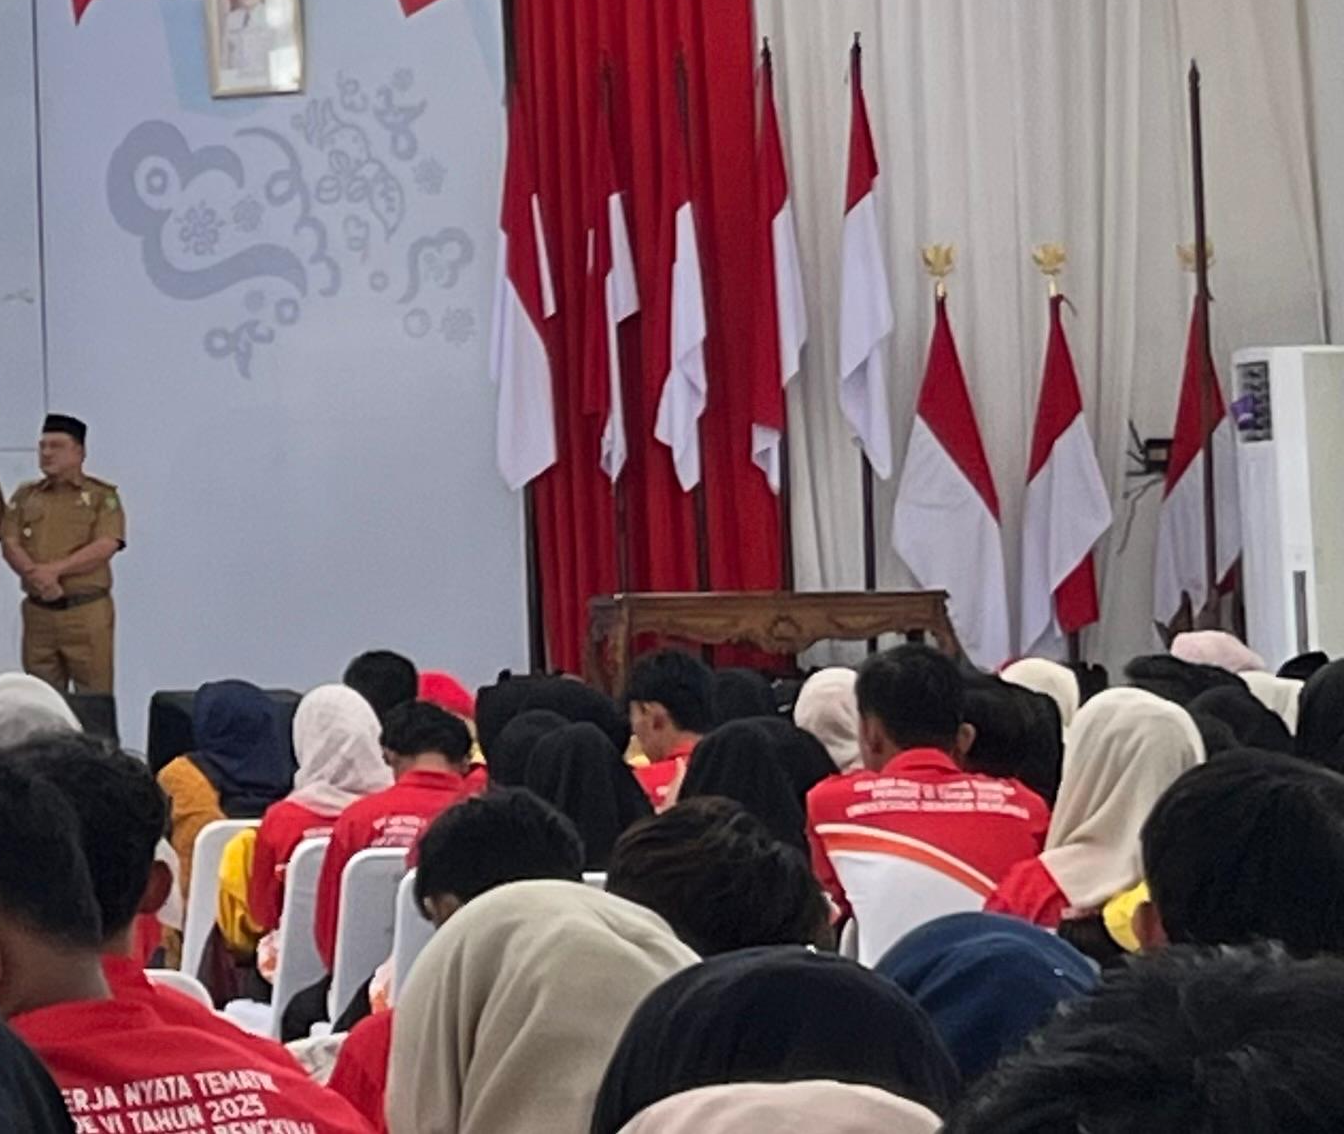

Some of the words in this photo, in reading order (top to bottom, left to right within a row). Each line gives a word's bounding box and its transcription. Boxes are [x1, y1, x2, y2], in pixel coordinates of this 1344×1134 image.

[61, 1085, 120, 1113] ERJA
[124, 1074, 192, 1107] NYATA
[98, 1113, 124, 1134] VI
[126, 1103, 205, 1134] TAHUN
[205, 1093, 267, 1122] 2025
